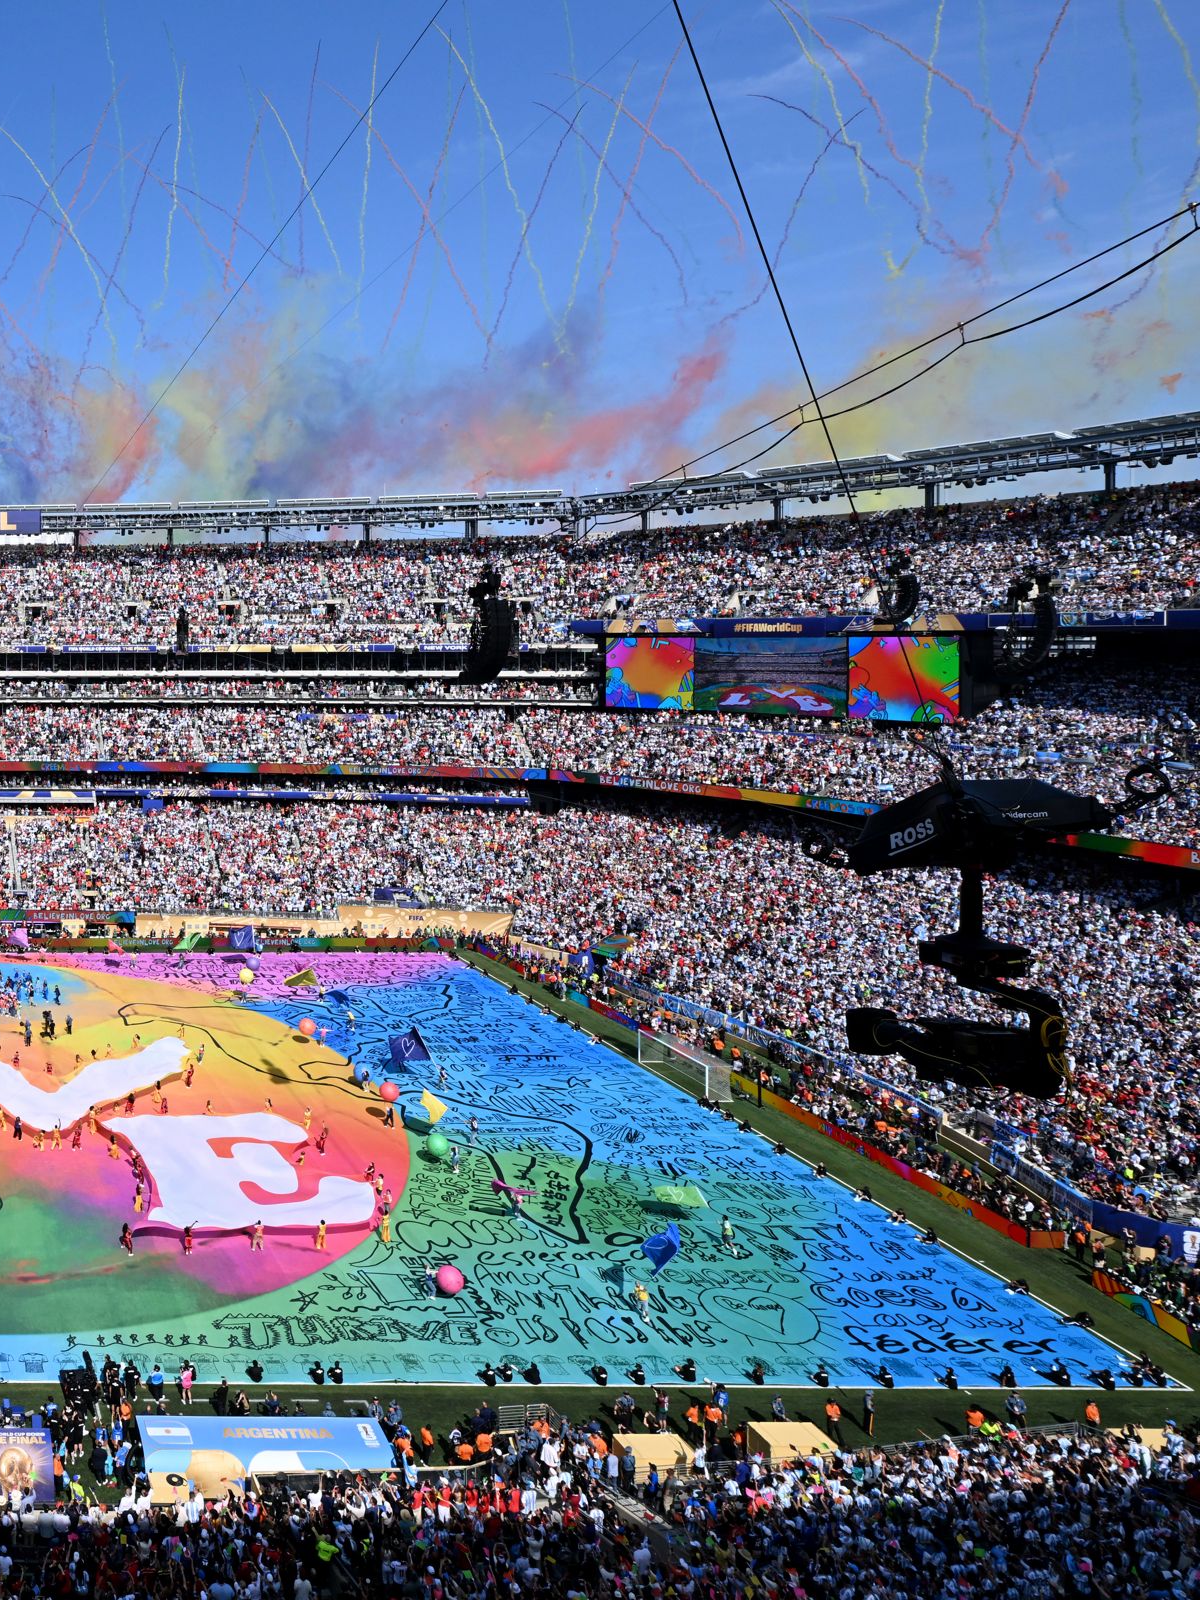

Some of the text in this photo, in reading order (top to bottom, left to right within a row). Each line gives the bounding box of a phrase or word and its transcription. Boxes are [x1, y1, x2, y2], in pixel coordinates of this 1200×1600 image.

[733, 622, 803, 634] #FIFAWorldCup
[599, 776, 702, 793] BELIEVEINLOVE.ORG
[889, 818, 934, 849] ROSS
[704, 1155, 759, 1171] take
[716, 1168, 794, 1181] action
[476, 1264, 555, 1288] Amor
[214, 1313, 482, 1349] THRIVE
[843, 1325, 1057, 1355] fédérer
[9, 1436, 46, 1445] FINAL
[222, 1427, 334, 1439] ARGENTINA
